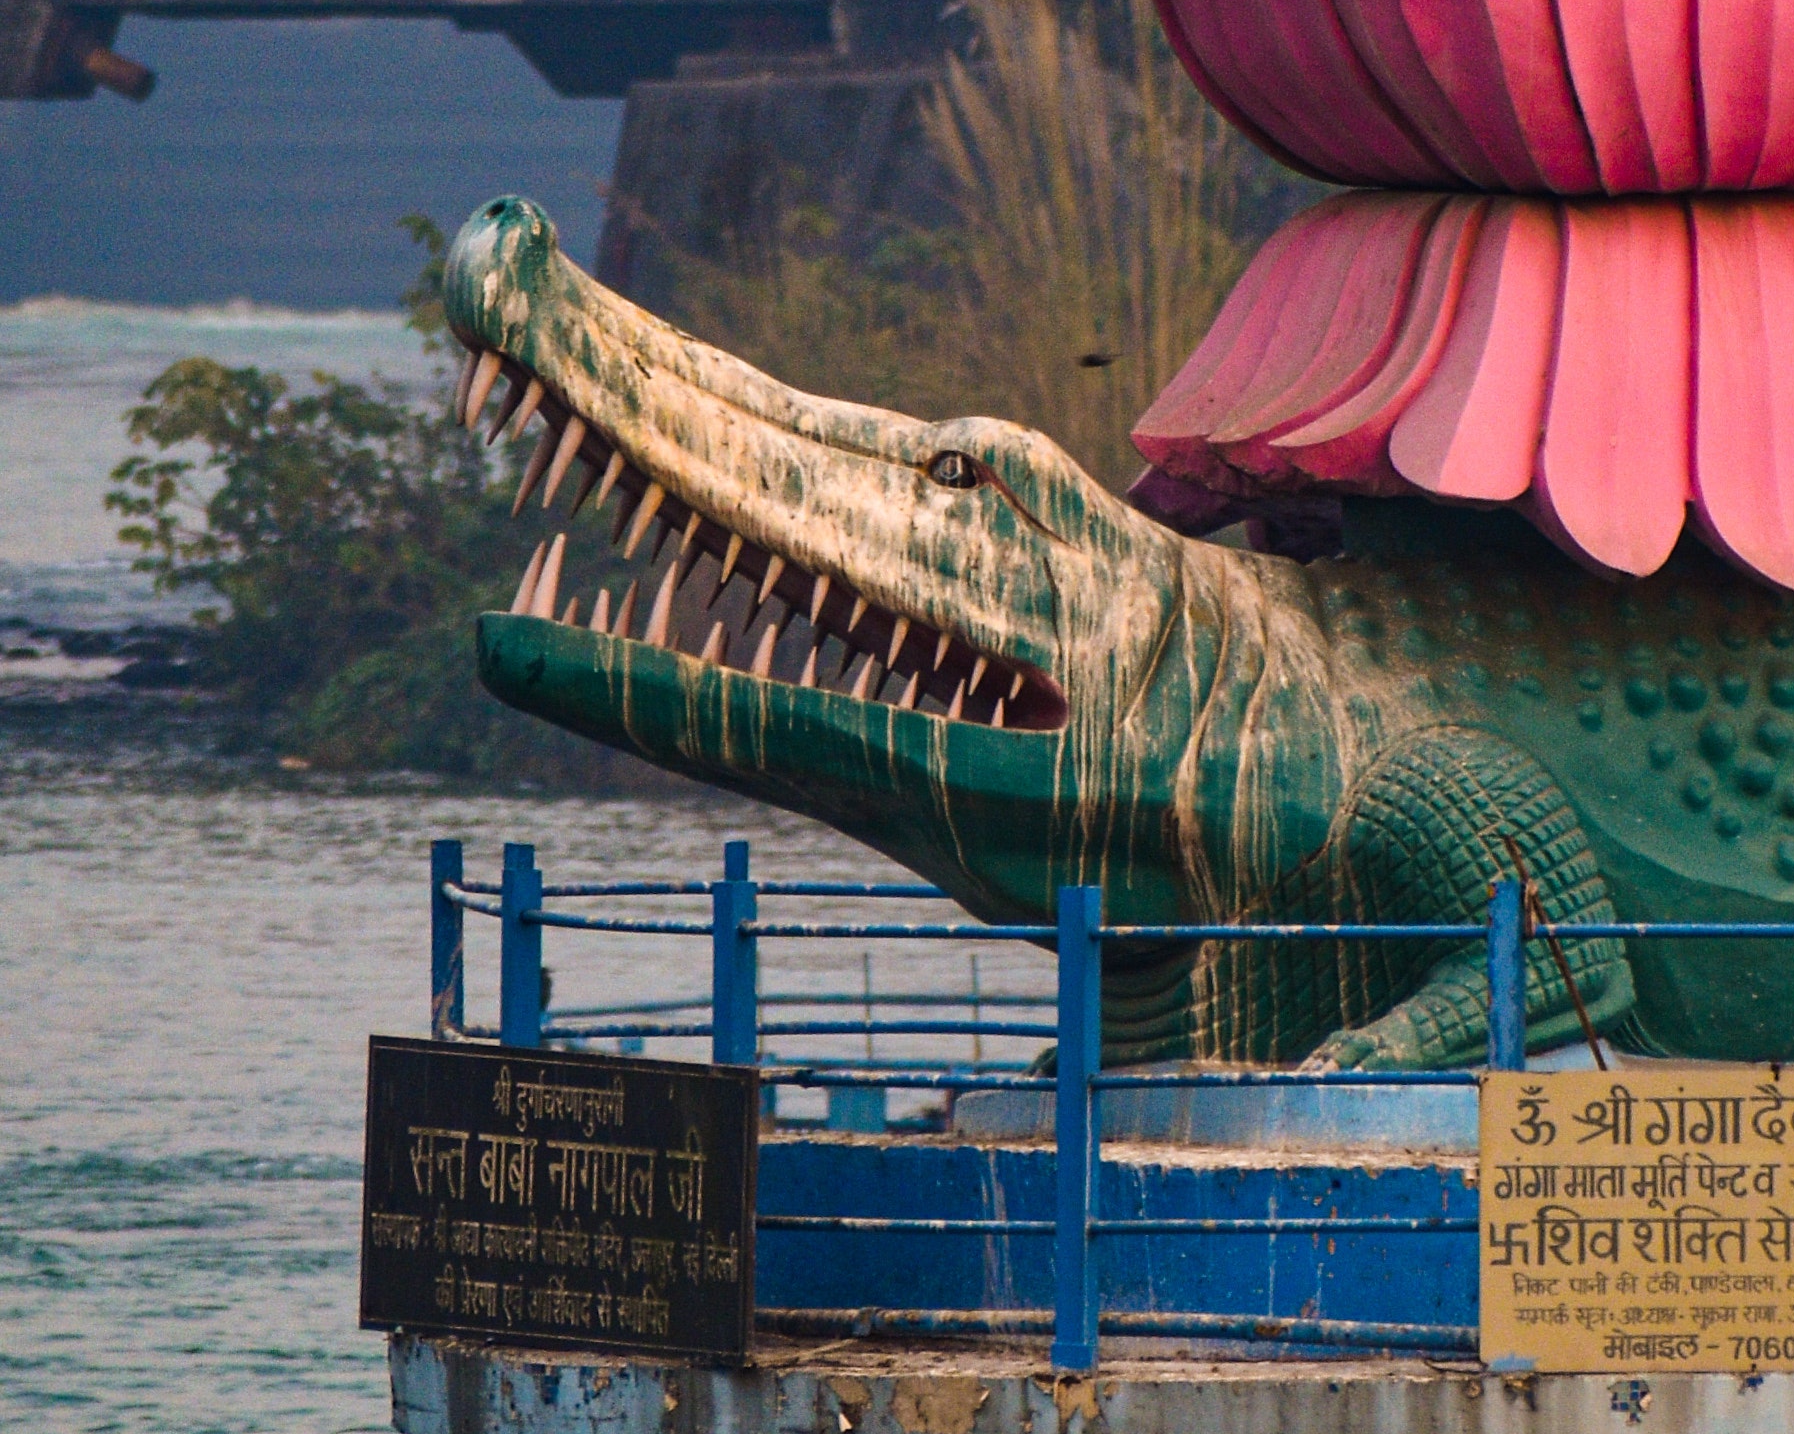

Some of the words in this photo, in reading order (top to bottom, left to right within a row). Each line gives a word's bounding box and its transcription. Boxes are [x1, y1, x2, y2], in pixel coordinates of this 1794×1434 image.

[1572, 1084, 1639, 1145] श्री
[1644, 1086, 1746, 1145] गंगा
[408, 1126, 470, 1200] सन्त
[478, 1133, 538, 1206] बाबा
[546, 1139, 658, 1219] नागपाल
[666, 1126, 707, 1222] जी
[1494, 1156, 1559, 1199] गंगा
[1564, 1164, 1626, 1199] माता
[1631, 1152, 1690, 1211] मूर्ति
[1532, 1204, 1623, 1266] शिव
[1627, 1204, 1750, 1264] शक्ति
[1512, 1271, 1560, 1296] निकट
[1569, 1271, 1608, 1296] पानी
[1615, 1271, 1638, 1295] की
[1603, 1329, 1699, 1361] मोबाइल
